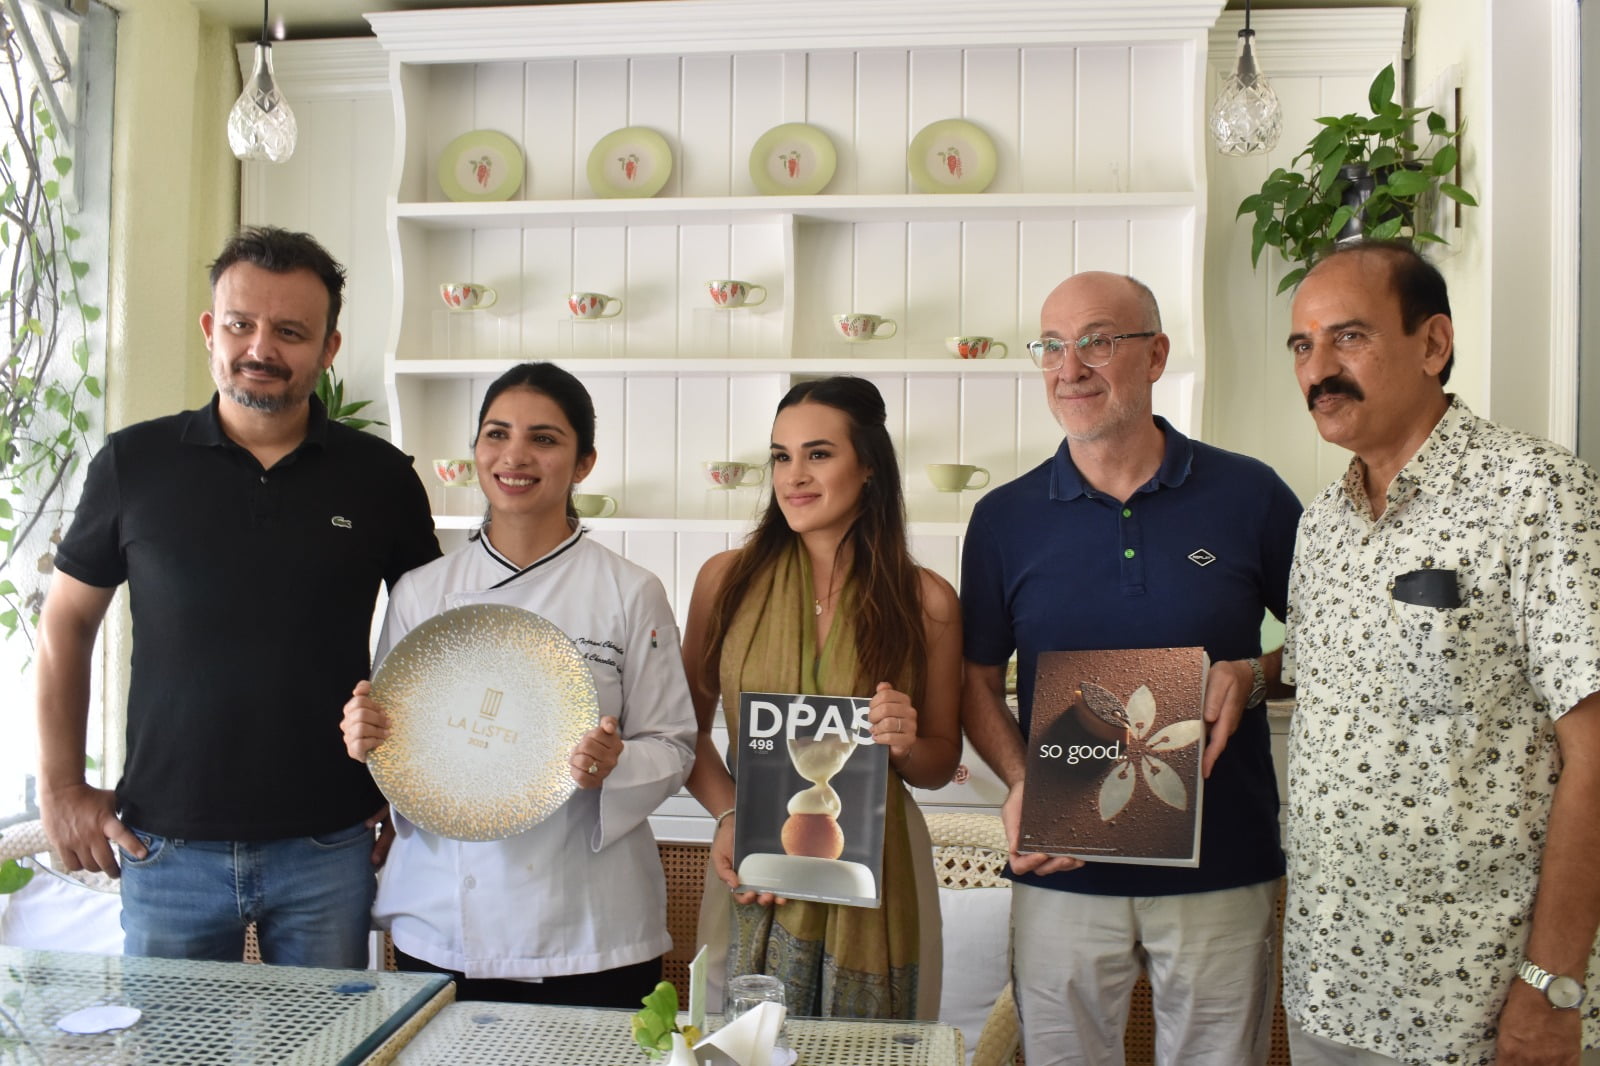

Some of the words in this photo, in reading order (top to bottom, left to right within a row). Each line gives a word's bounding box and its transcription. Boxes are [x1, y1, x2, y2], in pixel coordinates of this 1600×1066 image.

[447, 715, 467, 731] LA
[748, 700, 876, 746] DPAS
[748, 738, 774, 751] 498
[1039, 744, 1063, 759] so
